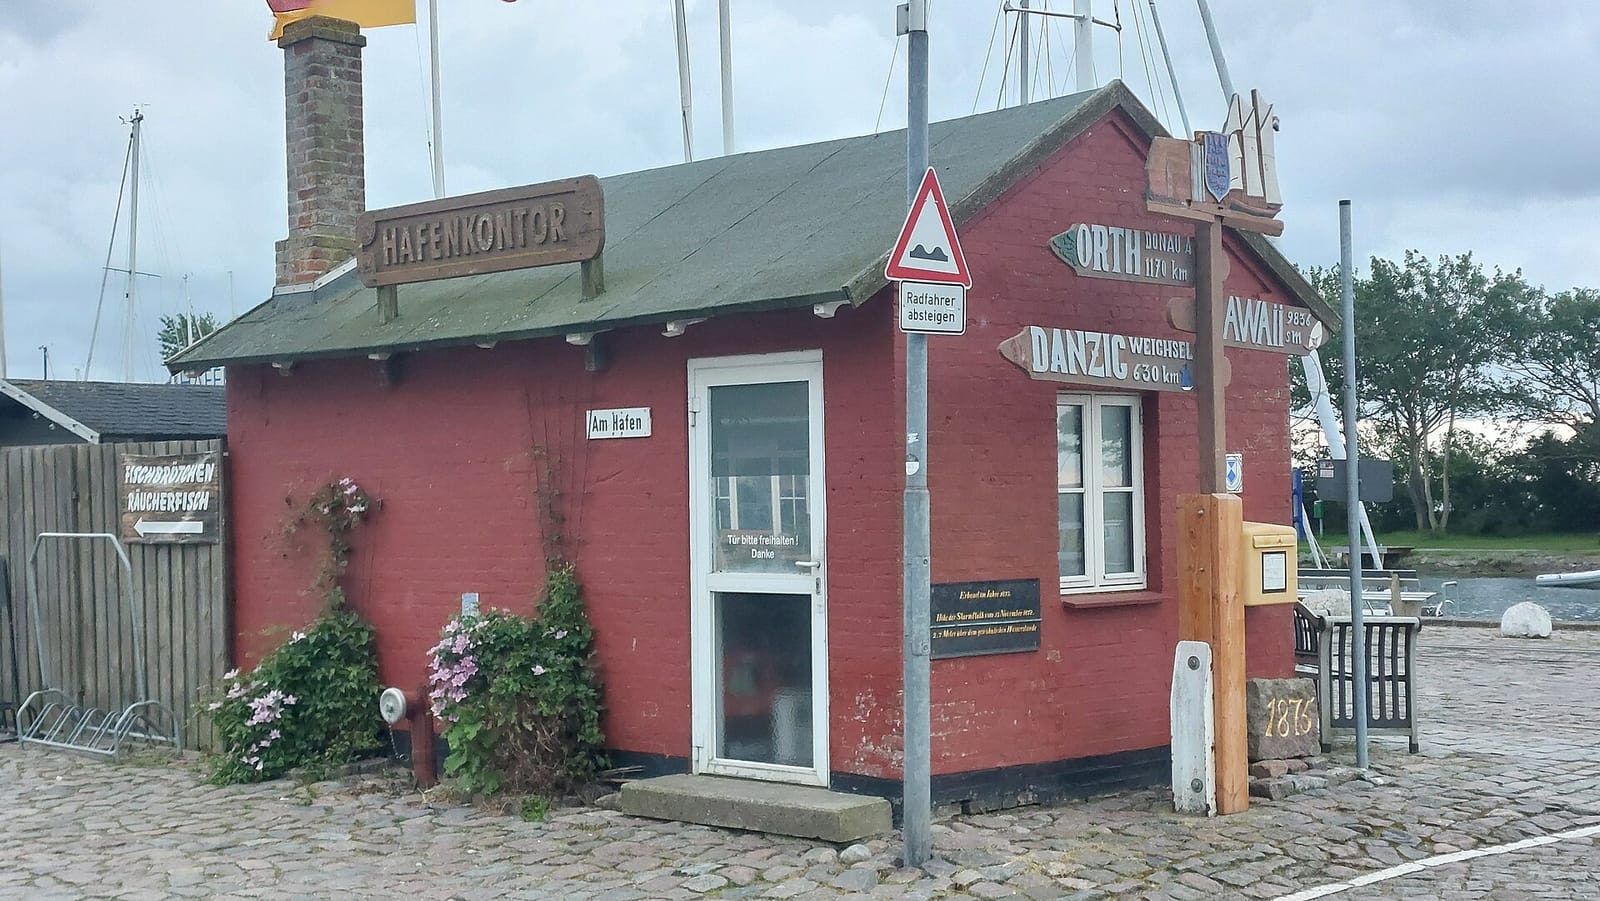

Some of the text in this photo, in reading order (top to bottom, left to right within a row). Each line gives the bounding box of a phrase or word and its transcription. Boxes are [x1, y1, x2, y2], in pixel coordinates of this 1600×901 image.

[383, 202, 568, 266] HAFENKONTOR
[1145, 231, 1181, 253] DONAU
[1077, 223, 1141, 275] ORTH
[1145, 258, 1188, 280] 1170 km
[906, 291, 956, 306] Radfahrer
[908, 308, 955, 325] absteigen
[1223, 296, 1312, 346] AWAii 9836
[1128, 336, 1194, 361] WEICHSEL
[1133, 363, 1179, 384] 630 km
[592, 414, 642, 432] Am Hafen
[125, 461, 215, 485] FISCHBRÖTCHEN
[127, 489, 210, 513] RÄUCHERFISCH
[727, 534, 741, 545] Tür
[741, 534, 758, 545] bitte
[759, 534, 795, 546] freihalten
[751, 548, 775, 559] Danke
